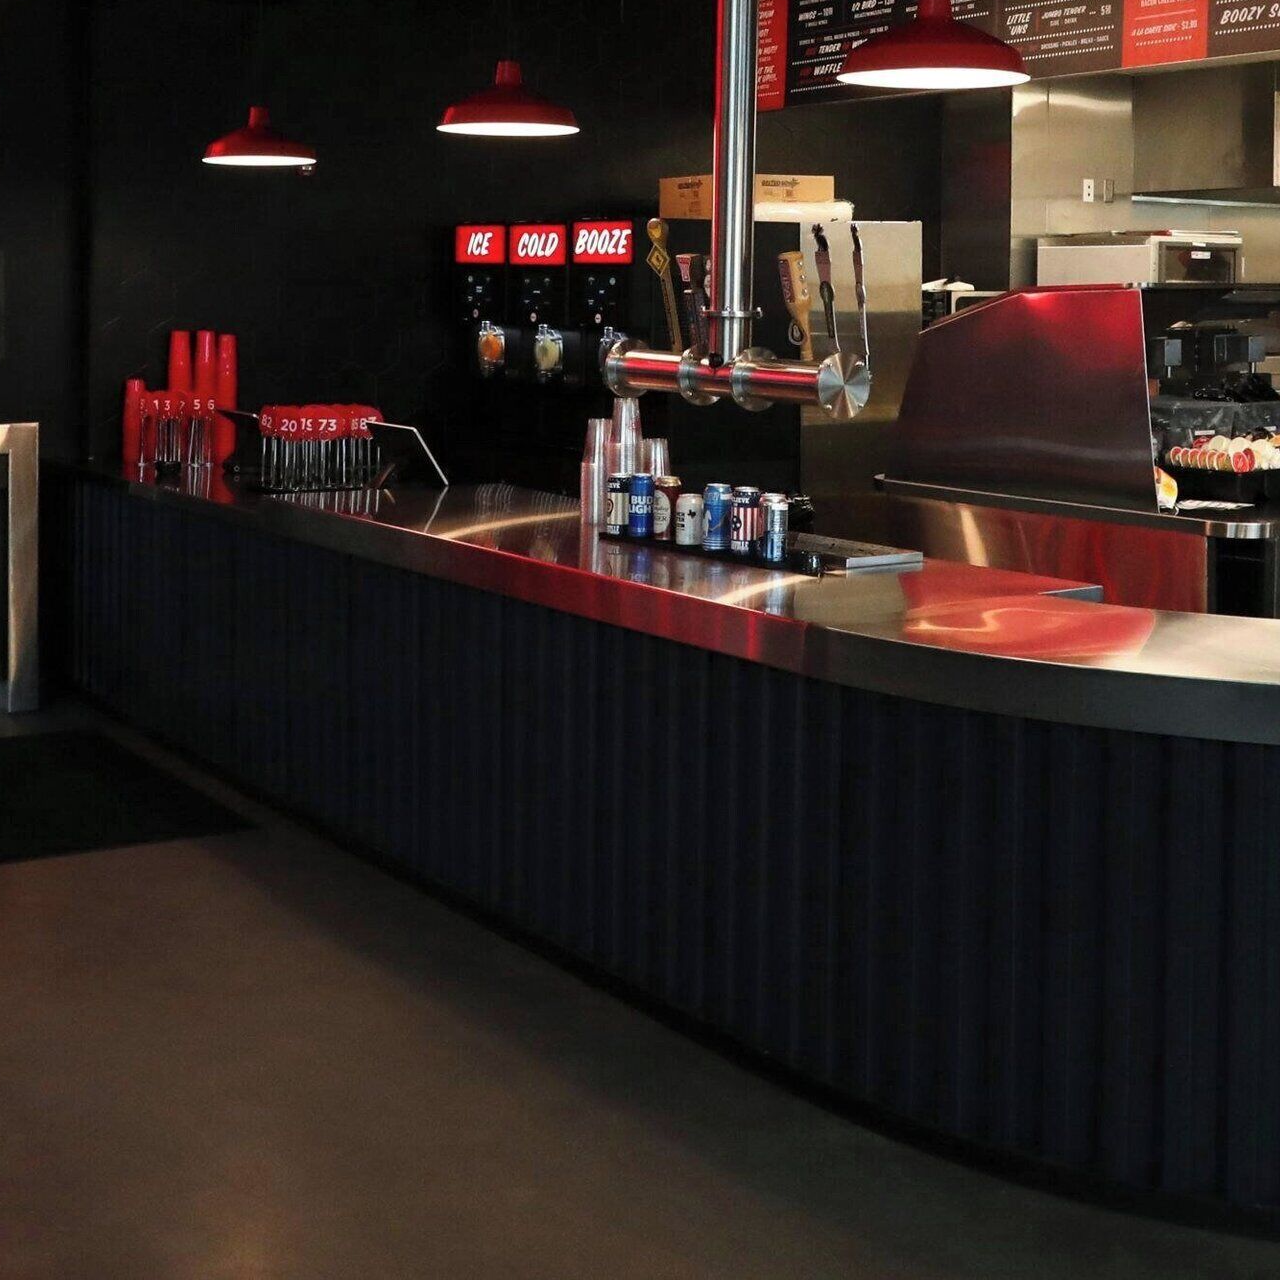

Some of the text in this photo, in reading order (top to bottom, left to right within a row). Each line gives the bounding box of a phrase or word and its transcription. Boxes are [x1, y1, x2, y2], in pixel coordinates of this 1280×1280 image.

[1006, 12, 1032, 25] LITTLE
[1220, 5, 1265, 25] BOOZY
[818, 43, 841, 54] TENDER
[814, 62, 842, 76] WAFFLE
[467, 228, 632, 258] ICE COLD BOOZE
[193, 399, 201, 410] 5
[207, 399, 215, 410] 6
[281, 419, 298, 433] 20
[318, 418, 337, 432] 73
[631, 496, 653, 505] BUD
